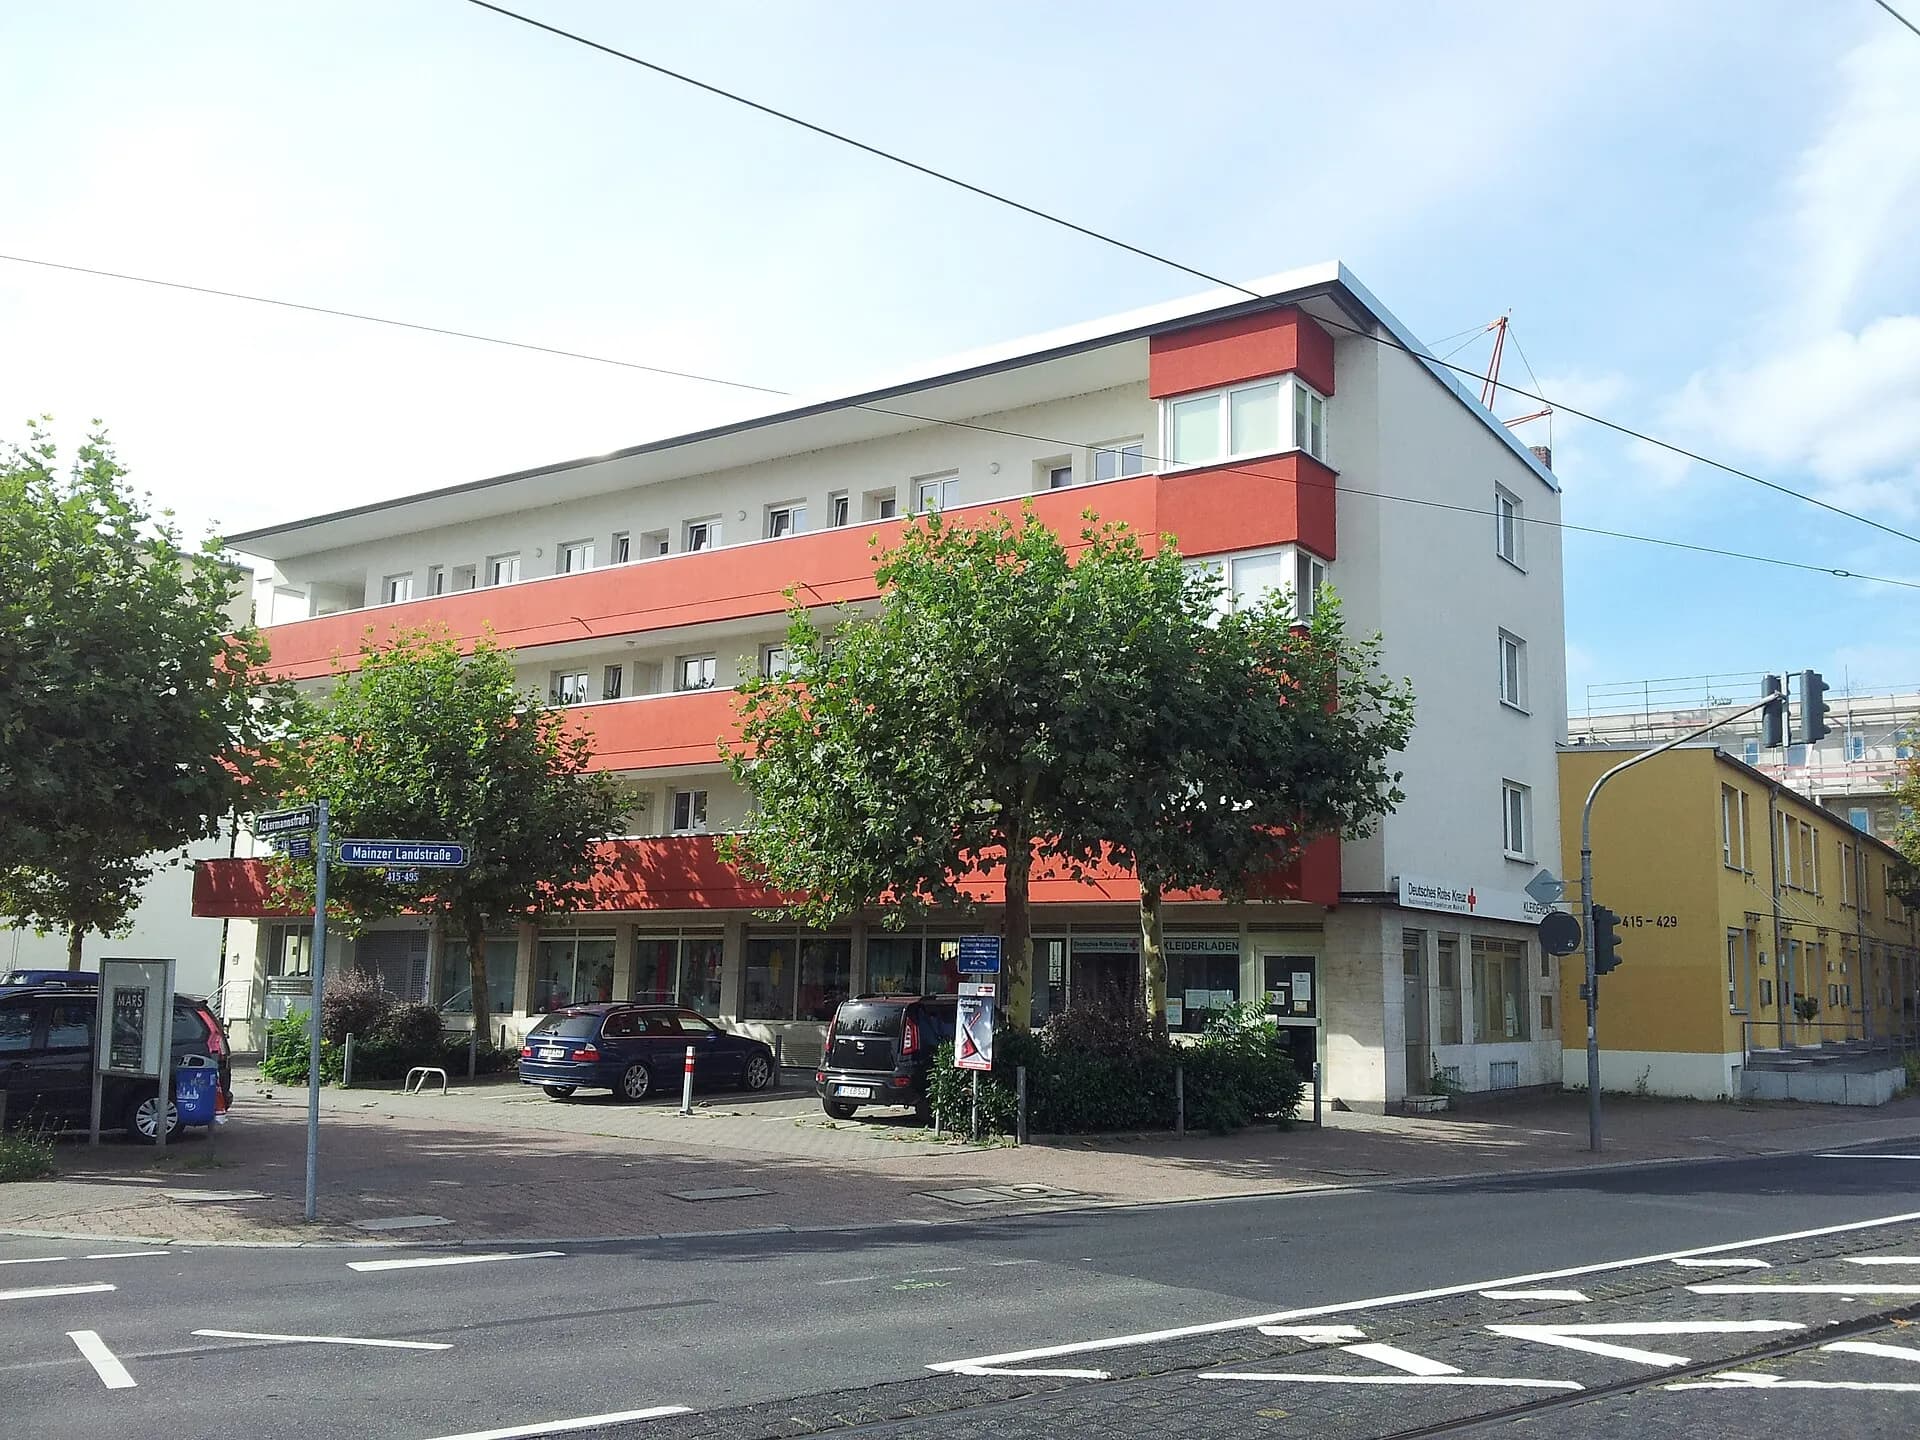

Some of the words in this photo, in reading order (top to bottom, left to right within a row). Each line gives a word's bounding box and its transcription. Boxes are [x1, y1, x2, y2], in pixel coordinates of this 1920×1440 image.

[258, 813, 310, 832] Ackermannstraße
[352, 846, 392, 859] Mainzer
[395, 847, 451, 861] Landstraße
[386, 872, 418, 882] 415-495
[1408, 882, 1437, 899] Deutsches
[1437, 887, 1451, 901] Rotes
[1452, 889, 1467, 903] Kreuz
[1164, 940, 1239, 951] KLEIDERLADEN
[117, 994, 143, 1008] MARS
